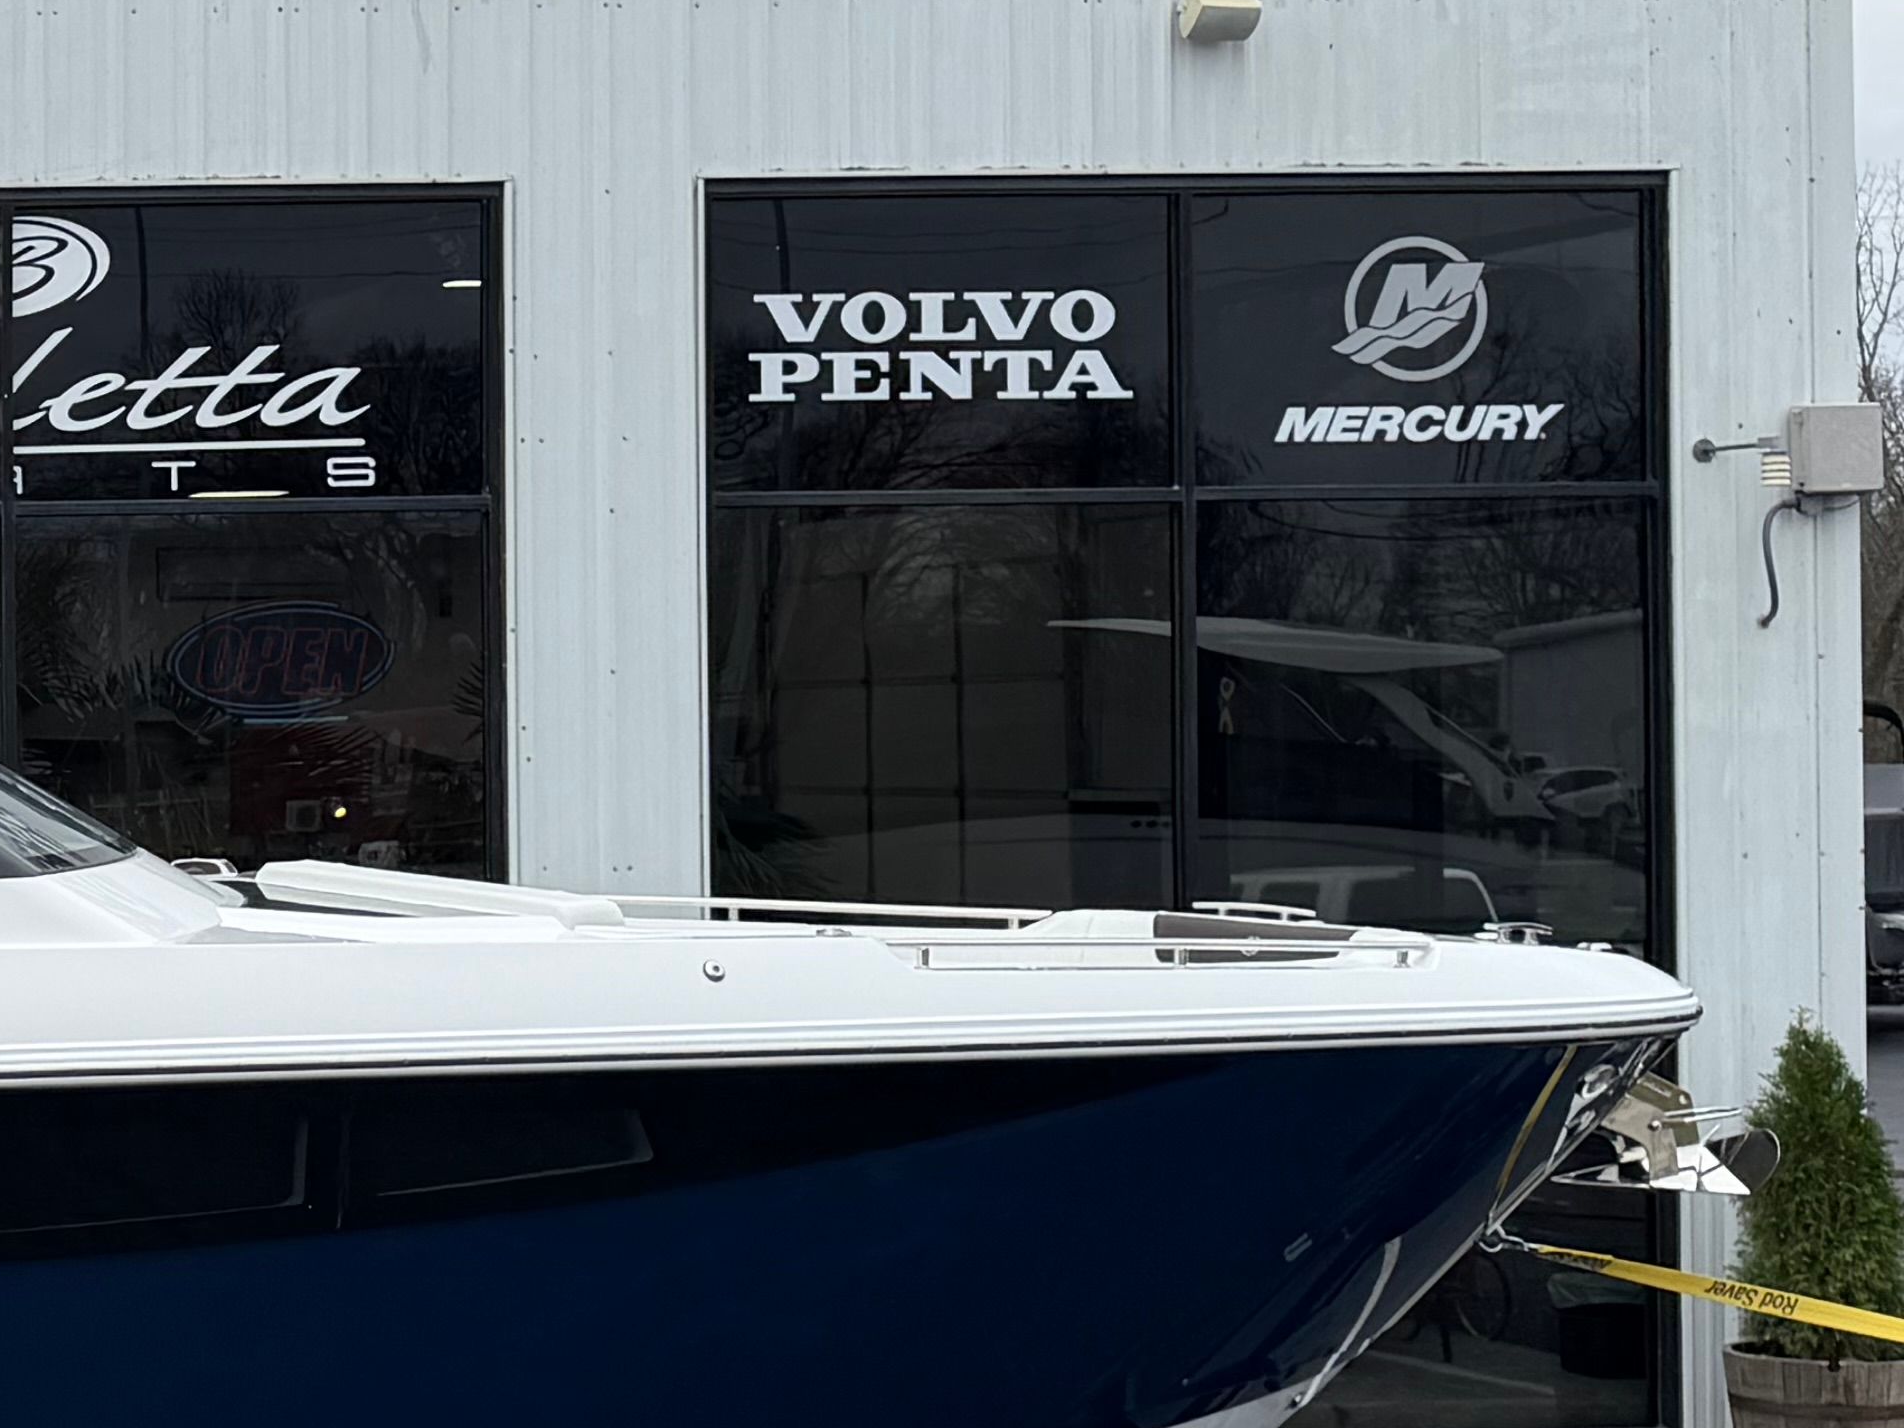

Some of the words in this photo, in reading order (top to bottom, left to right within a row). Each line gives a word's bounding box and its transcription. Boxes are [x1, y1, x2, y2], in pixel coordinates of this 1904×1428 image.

[753, 289, 1116, 344] VOLVO
[748, 349, 1134, 403] PENTA
[1274, 403, 1565, 443] MERCURY
[196, 625, 368, 696] OPEN
[1704, 1279, 1760, 1307] Saver
[1762, 1290, 1799, 1316] Rod
